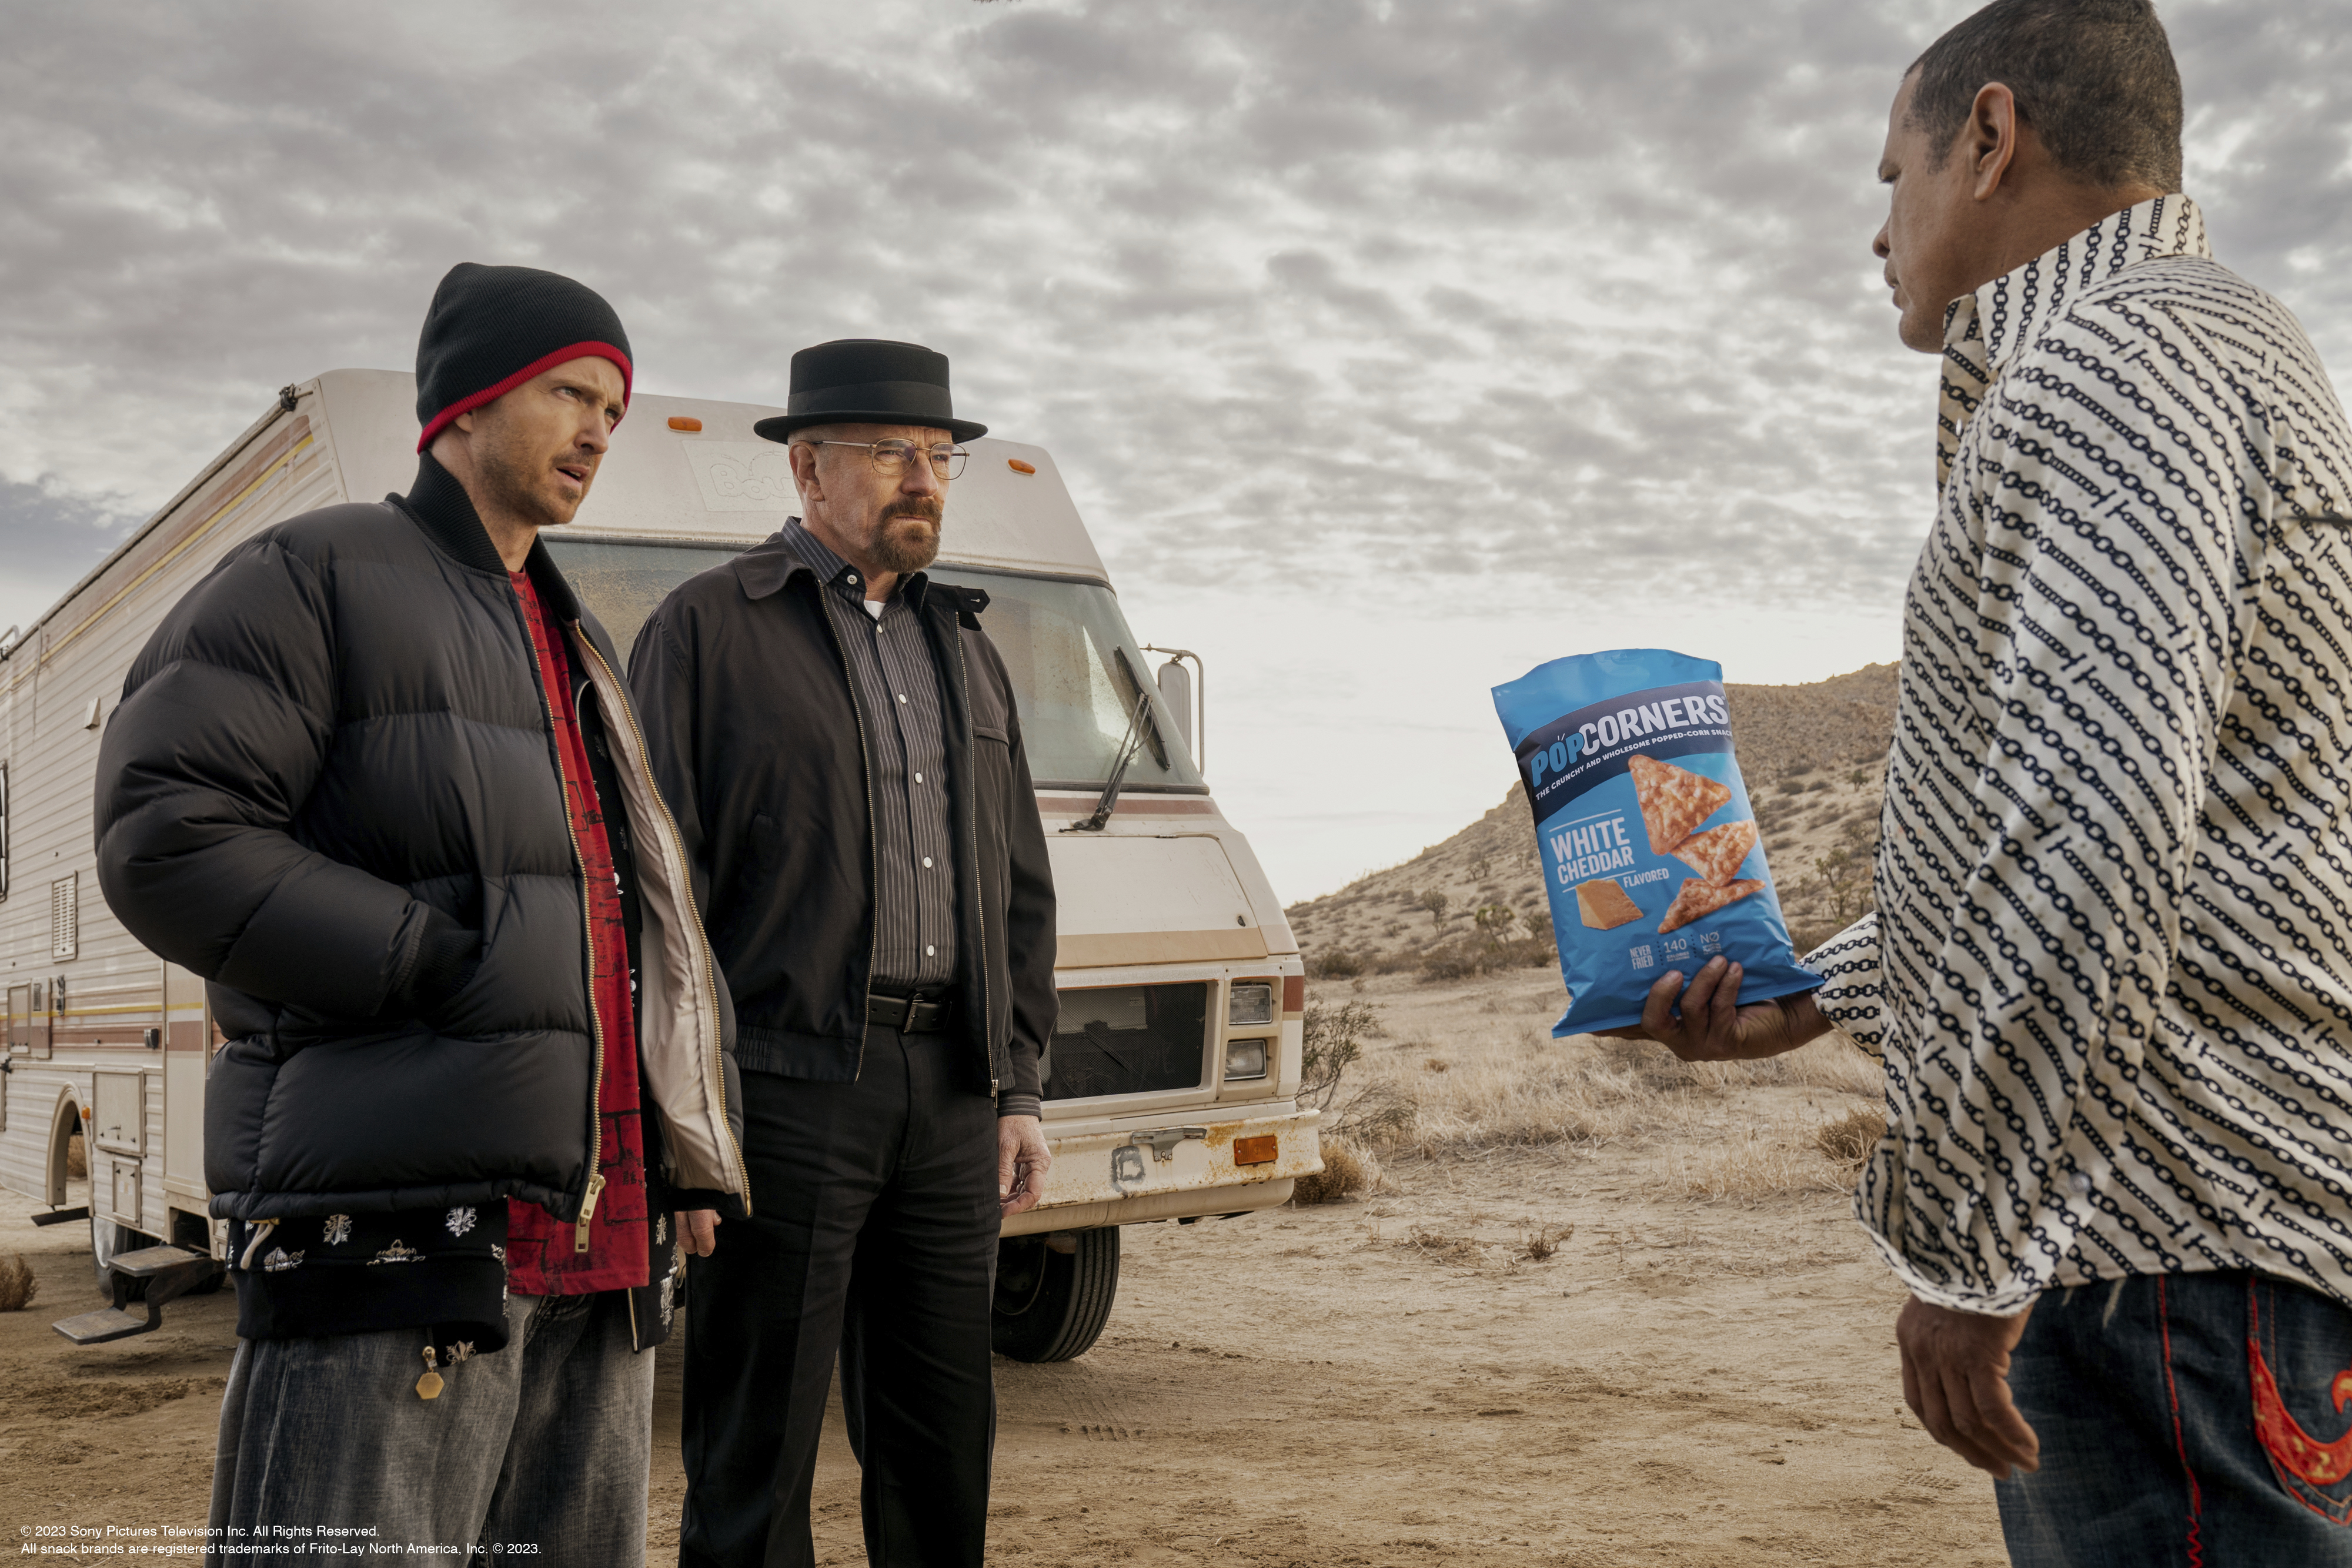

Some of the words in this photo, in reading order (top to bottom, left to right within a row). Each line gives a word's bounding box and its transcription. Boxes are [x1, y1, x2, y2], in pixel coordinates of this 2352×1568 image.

[710, 463, 803, 500] Bou
[1535, 787, 1550, 800] THE
[1551, 765, 1584, 790] CRUNCHY
[1586, 757, 1601, 770] AND
[1602, 740, 1651, 760] WHOLESOME
[1651, 730, 1710, 744] POPPED-CORN
[1550, 817, 1631, 863] WHITE
[1557, 845, 1635, 884] CHEDDAR
[1623, 868, 1669, 888] FLAVORED
[1629, 944, 1652, 958] NEVER
[1663, 938, 1687, 953] 140
[1632, 955, 1654, 969] FRIED
